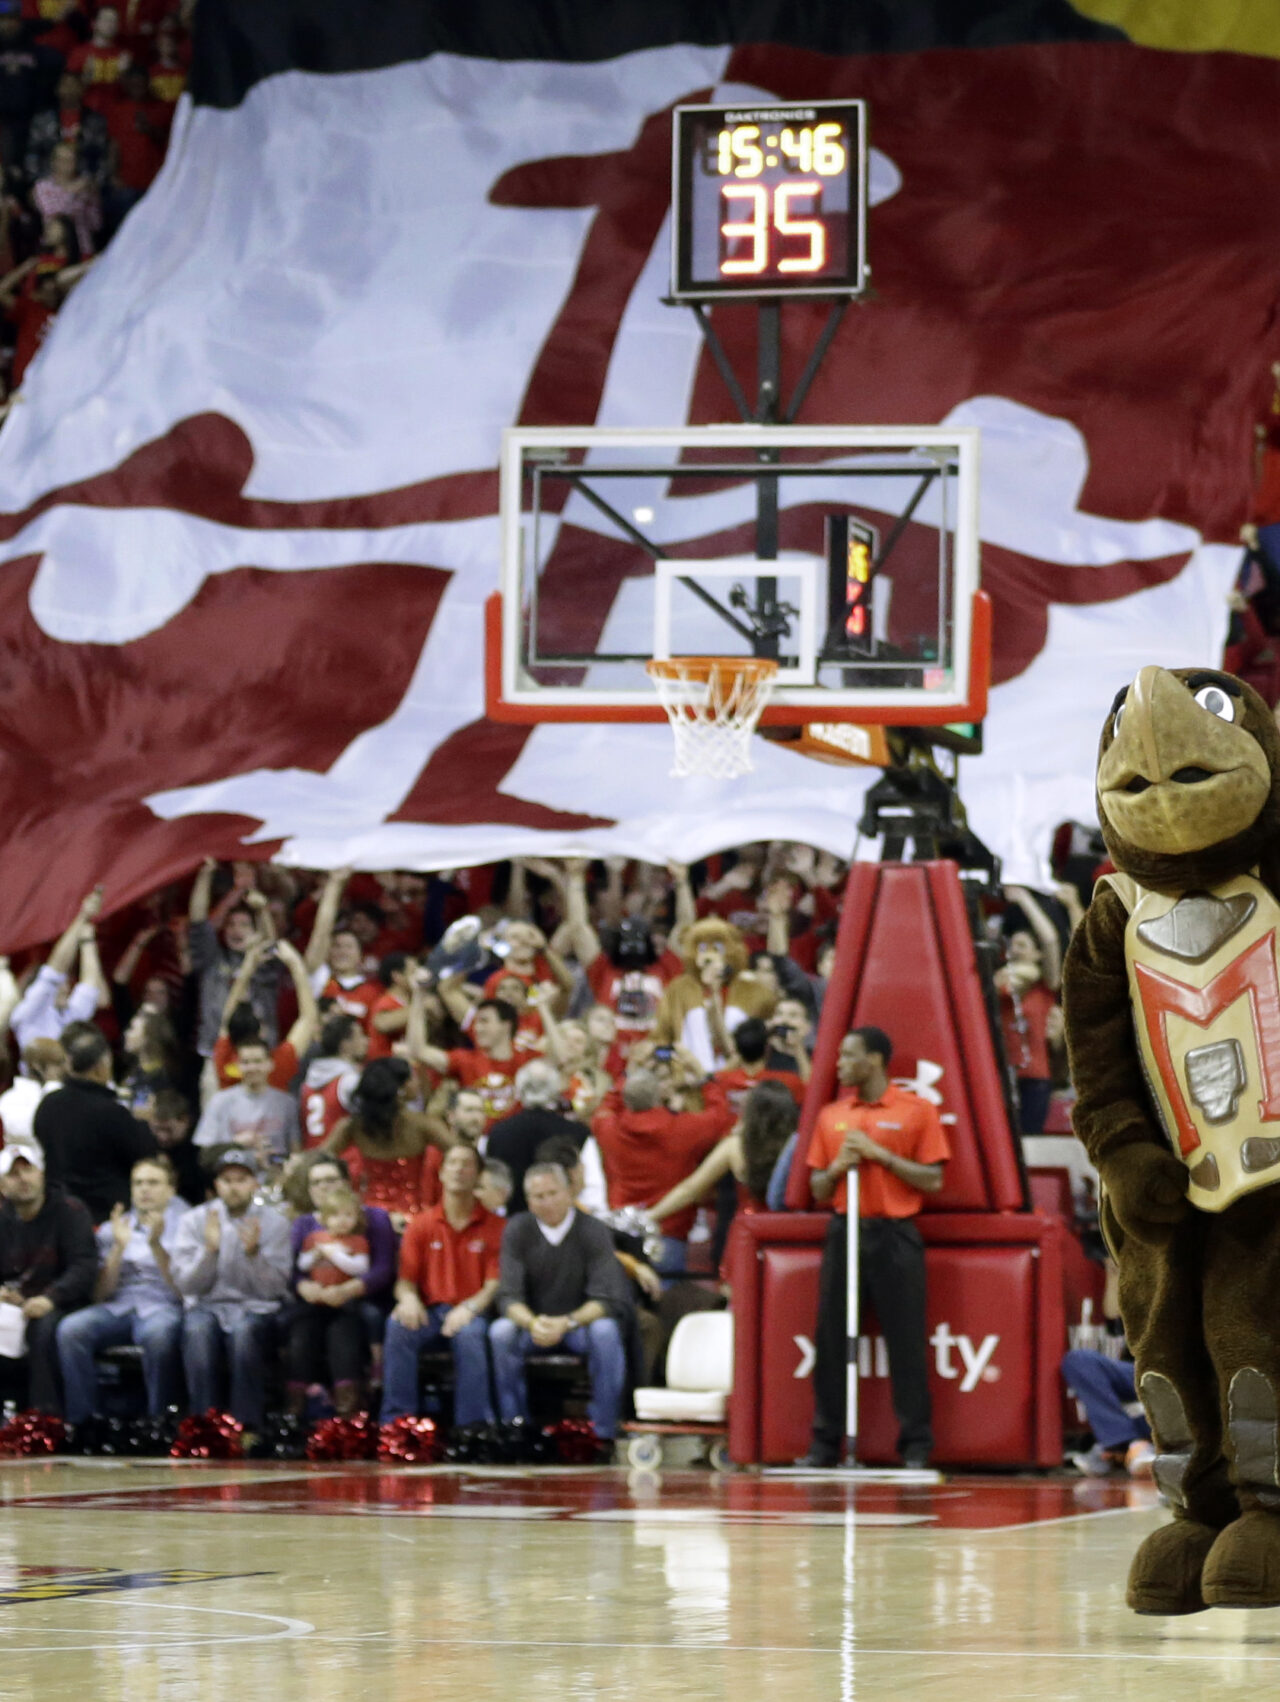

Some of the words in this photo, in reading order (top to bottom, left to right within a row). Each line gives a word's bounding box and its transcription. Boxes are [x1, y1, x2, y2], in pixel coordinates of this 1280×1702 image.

[717, 122, 846, 178] 15:46
[720, 180, 826, 275] 35
[306, 1094, 326, 1137] 2
